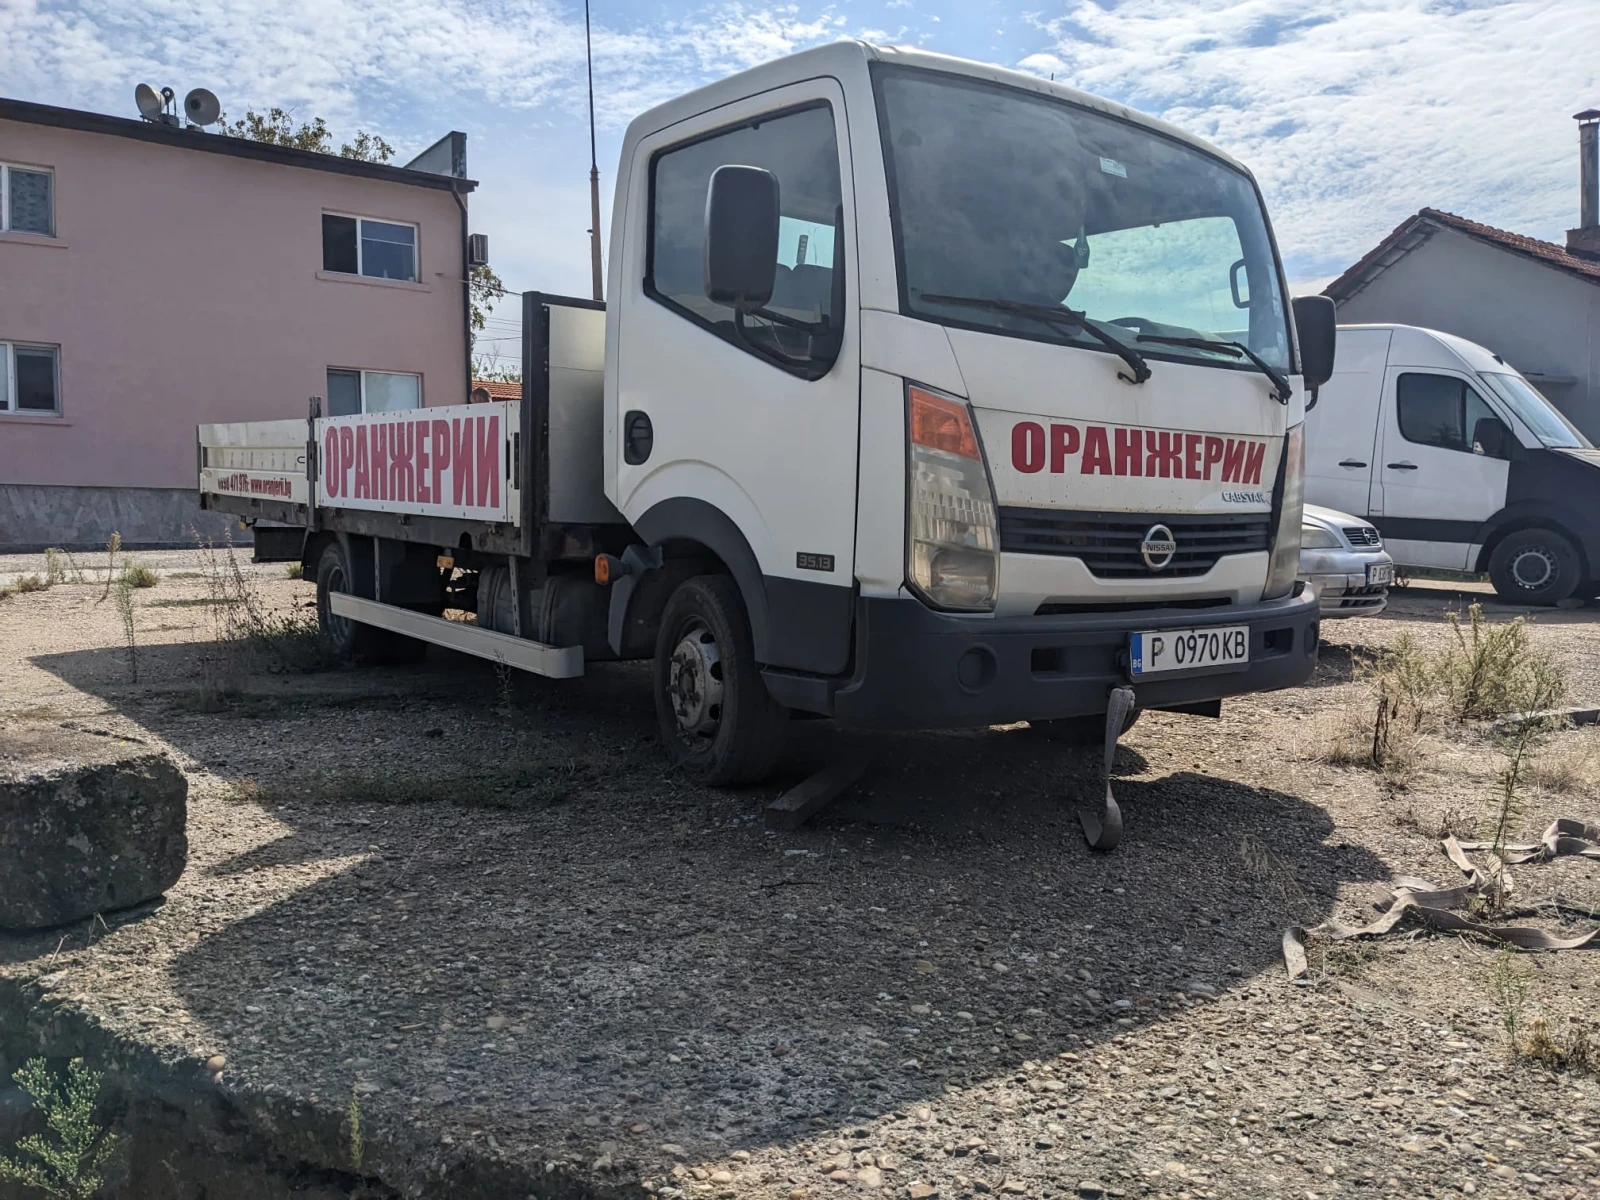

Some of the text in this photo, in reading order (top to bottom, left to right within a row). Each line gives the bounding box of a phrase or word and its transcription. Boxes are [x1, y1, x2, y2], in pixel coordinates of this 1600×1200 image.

[325, 416, 499, 508] ОРАНЖЕРИИ
[1011, 421, 1266, 485] ОРАНЖЕРИИ
[799, 554, 831, 569] 35.13
[1147, 544, 1175, 552] NISSAN
[1132, 658, 1142, 668] BG
[1151, 637, 1165, 667] P
